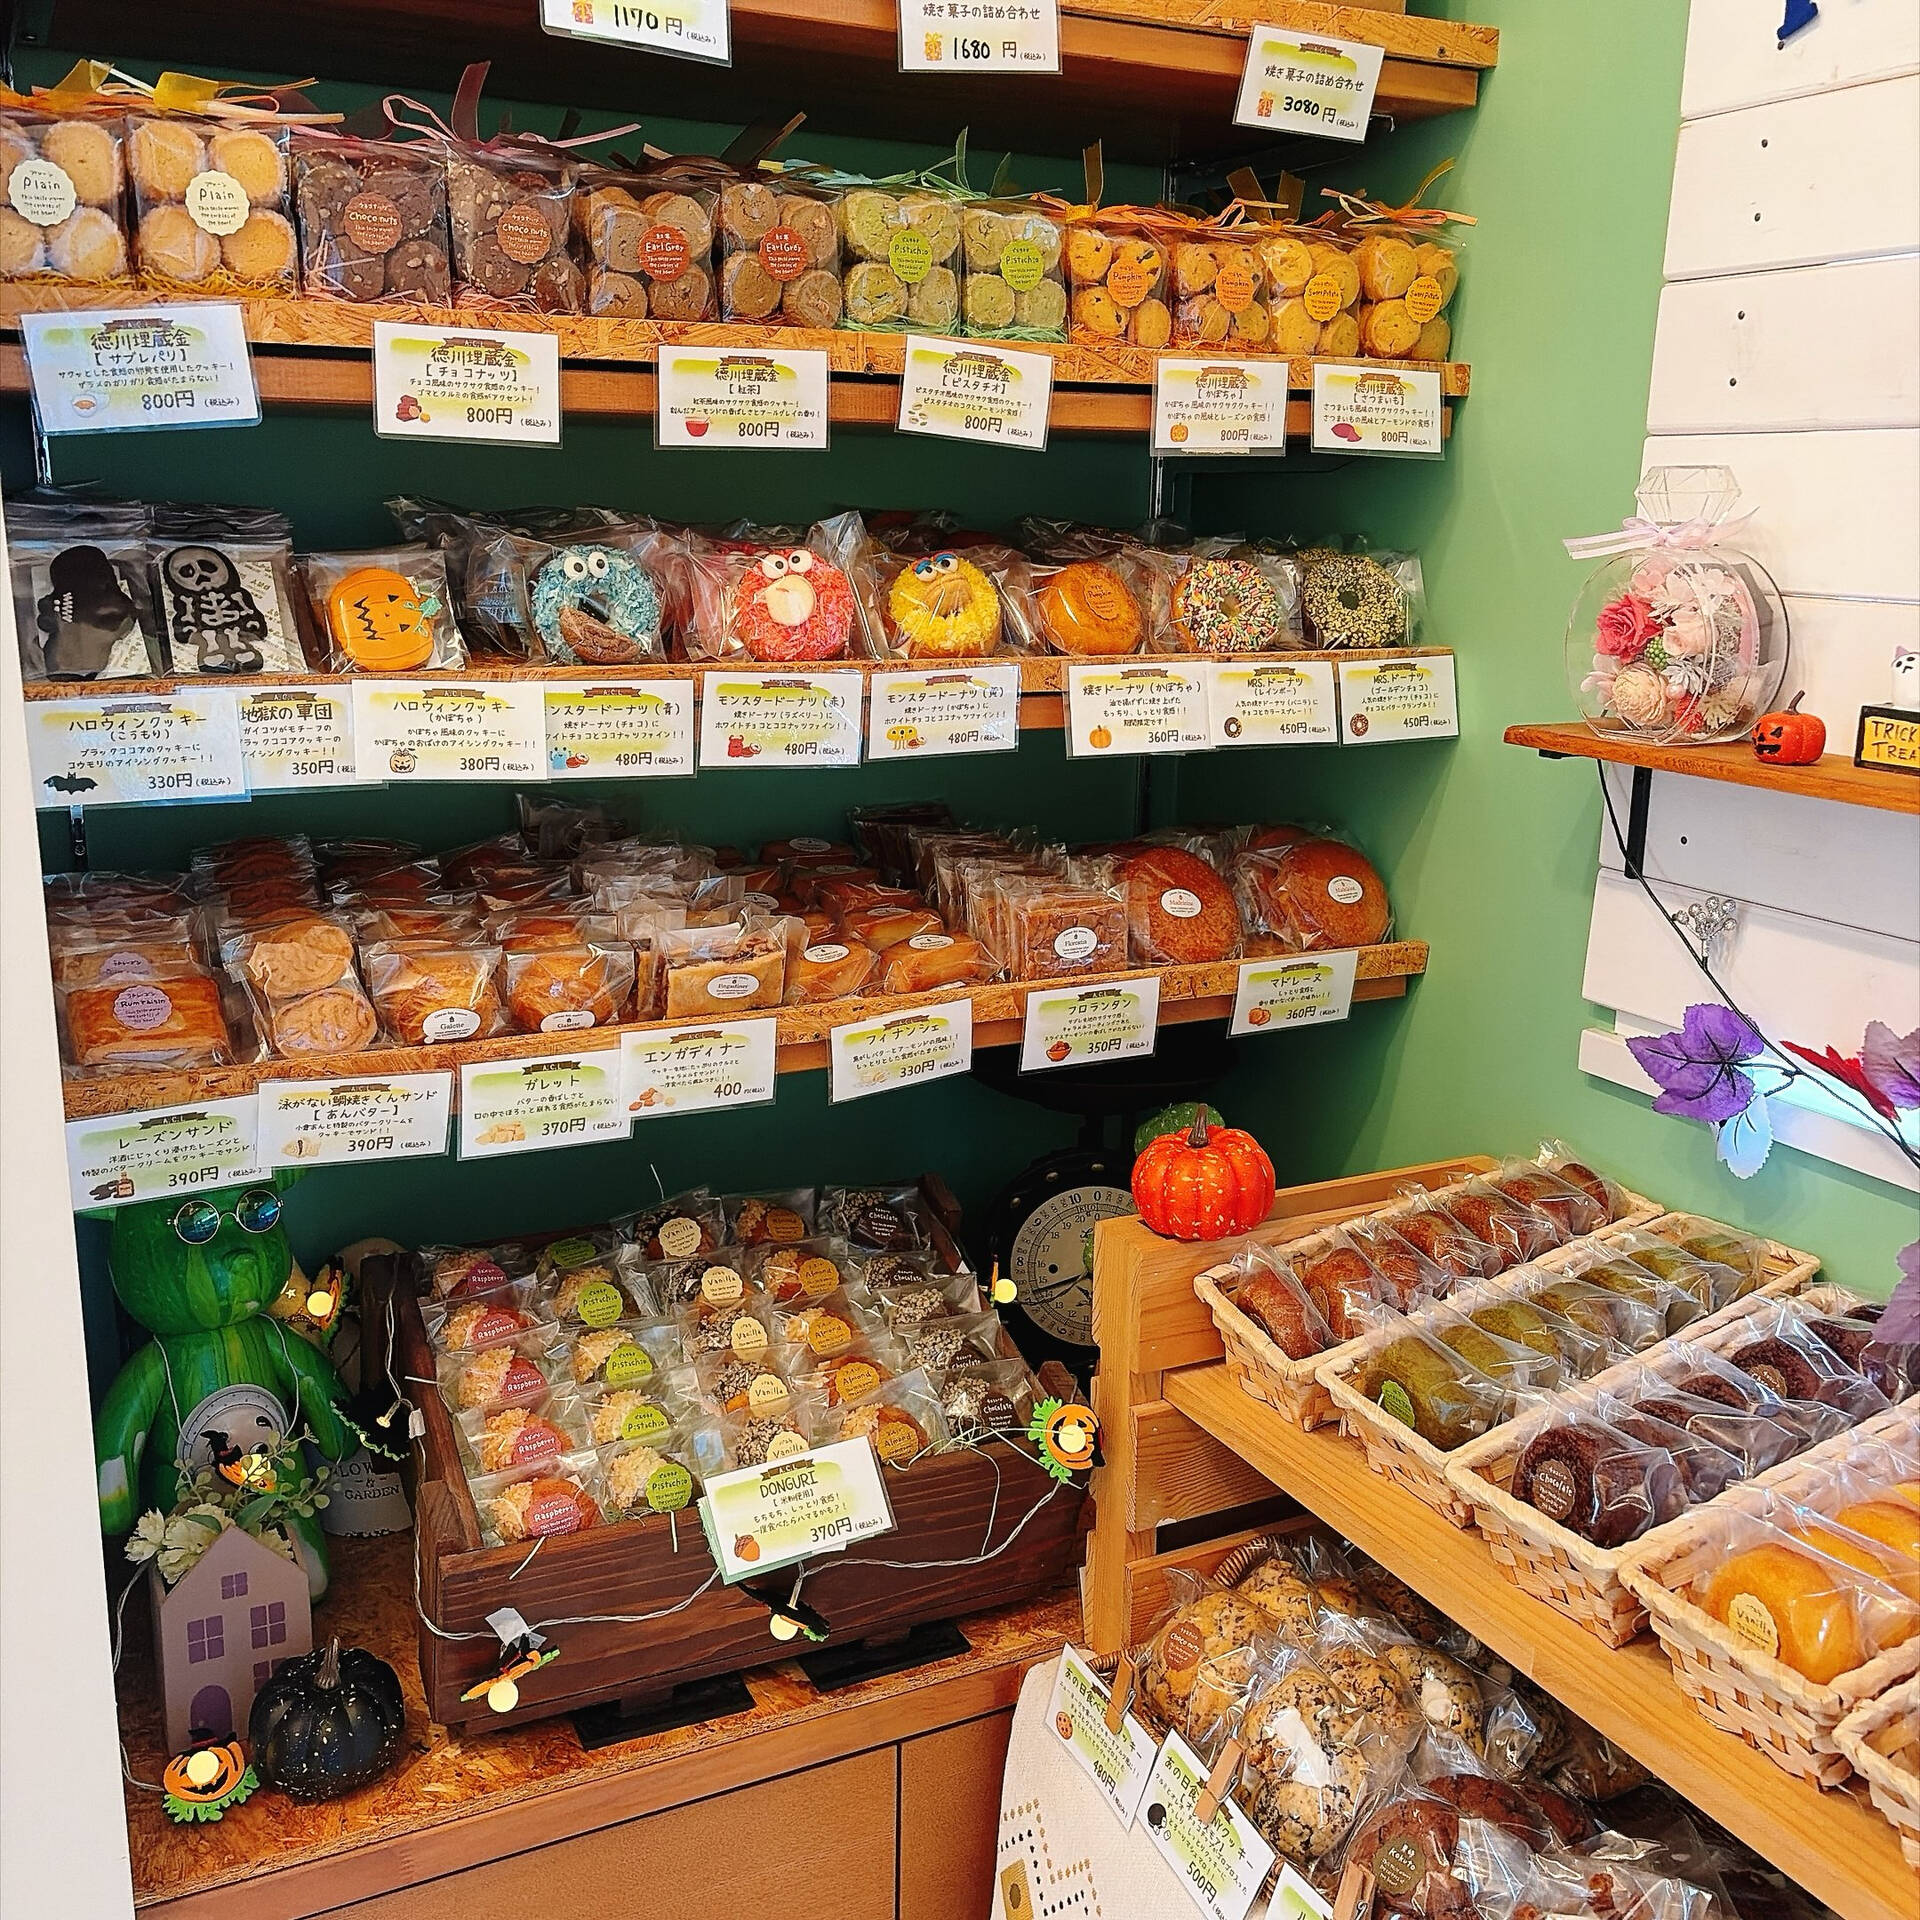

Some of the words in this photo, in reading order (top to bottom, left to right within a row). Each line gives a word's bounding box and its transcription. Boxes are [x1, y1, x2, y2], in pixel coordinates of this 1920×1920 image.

[923, 3, 1041, 20] 焼き菓子の詰め合わせ
[614, 5, 659, 31] 1170
[665, 17, 683, 36] 円
[954, 38, 990, 60] 1680
[1002, 41, 1017, 58] 円
[1265, 65, 1365, 92] 焼き菓子の詰め合わせ
[23, 177, 60, 191] Plain
[199, 188, 234, 200] Plain
[349, 211, 377, 222] Choco
[379, 215, 398, 225] nuts
[502, 224, 529, 234] Choco
[90, 329, 191, 350] 徳川埋蔵金
[431, 348, 518, 368] 徳川埋蔵金
[715, 368, 779, 382] 徳川埋蔵金
[943, 360, 1012, 383] 徳川埋蔵金
[1196, 376, 1250, 389] 徳川埋蔵金
[1355, 382, 1406, 396] 徳川埋蔵金
[142, 390, 194, 410] 800円
[467, 407, 513, 425] 800円
[965, 415, 1002, 433] 800円
[738, 422, 779, 438] 800円
[1221, 429, 1249, 441] 800円
[1381, 432, 1408, 443] 800円
[393, 701, 516, 713] ハロウィンクッキー
[69, 714, 207, 731] ハロウィンクッキー
[1280, 722, 1307, 734] 450円
[1404, 715, 1429, 728] 450円
[949, 731, 979, 744] 480円
[1149, 729, 1179, 744] 360円
[1872, 721, 1917, 743] TRICK
[785, 742, 817, 755] 480円
[1872, 742, 1920, 760] TREA
[460, 757, 500, 771] 380円
[616, 752, 652, 766] 480円
[292, 760, 334, 775] 350円
[149, 772, 192, 789] 330円
[1271, 973, 1322, 988] マドレーヌ
[1068, 999, 1131, 1015] フロランタン
[1286, 1006, 1316, 1020] 360円
[867, 1024, 940, 1046] フィナンシェ
[644, 1043, 746, 1064] エンガディナー
[1088, 1038, 1122, 1054] 350円
[900, 1060, 935, 1078] 330円
[525, 1075, 580, 1091] ガレット
[714, 1082, 742, 1098] 400
[541, 1117, 586, 1136] 370円
[119, 1121, 233, 1149] レーズンサンド
[347, 1136, 393, 1153] 390円
[168, 1166, 219, 1187] 390円
[1070, 1193, 1082, 1204] 10
[664, 1224, 694, 1239] Vanilla
[707, 1275, 737, 1284] Vanilla
[477, 1323, 514, 1340] Raspberry
[507, 1378, 541, 1392] Raspberry
[754, 1387, 783, 1398] Vanilla
[518, 1437, 556, 1454] Raspberry
[760, 1470, 819, 1498] DONGURI
[1540, 1473, 1572, 1496] Chocolate
[344, 1485, 400, 1500] GARDEN
[534, 1504, 574, 1522] Raspberry
[810, 1516, 853, 1543] 370円
[1736, 1608, 1770, 1636] Vanilla
[1093, 1760, 1116, 1794] 480円
[1389, 1848, 1415, 1870] Kokuto
[1186, 1862, 1217, 1903] 500円
